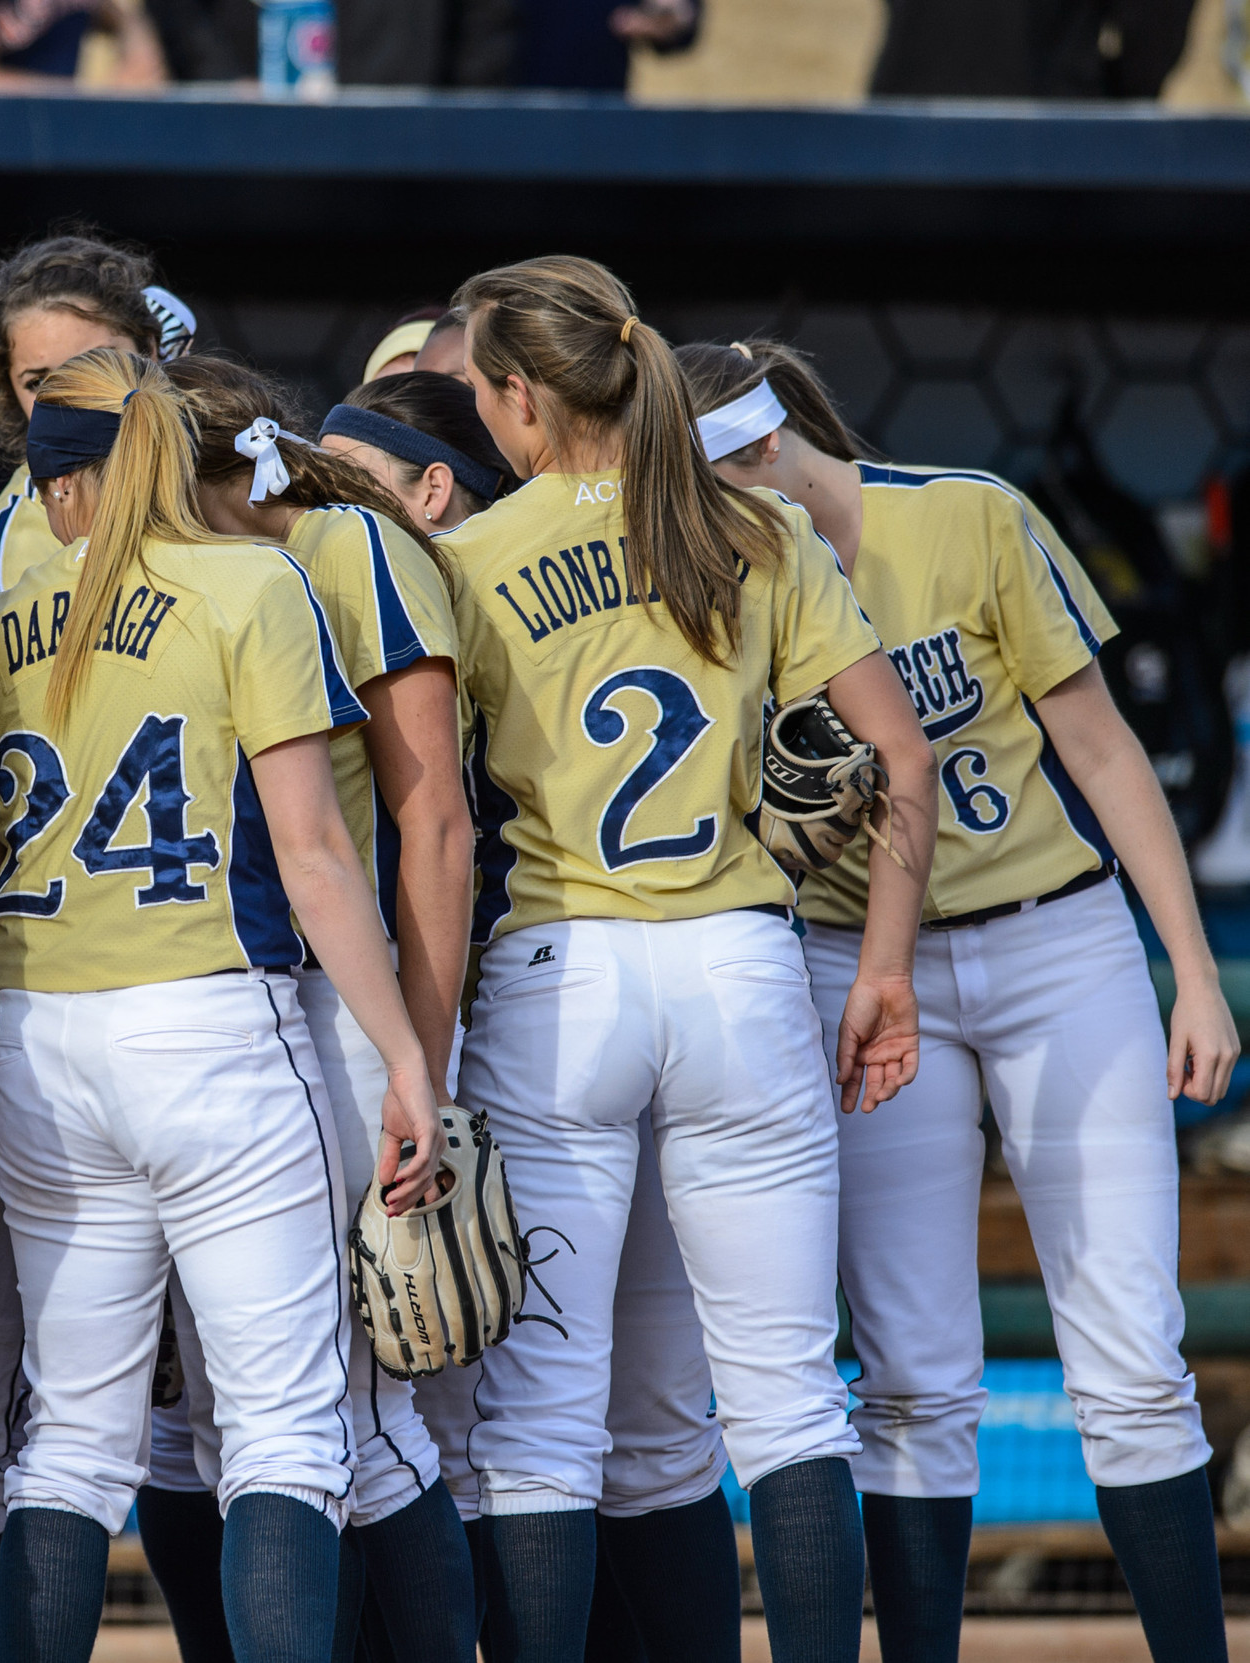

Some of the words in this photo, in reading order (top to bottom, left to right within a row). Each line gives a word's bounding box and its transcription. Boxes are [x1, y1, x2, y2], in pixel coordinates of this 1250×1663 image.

[0, 584, 178, 676] DARAGH
[886, 627, 977, 720] ECH
[580, 665, 717, 874] 2
[939, 747, 1011, 835] 6
[403, 1272, 431, 1346] WORTH
